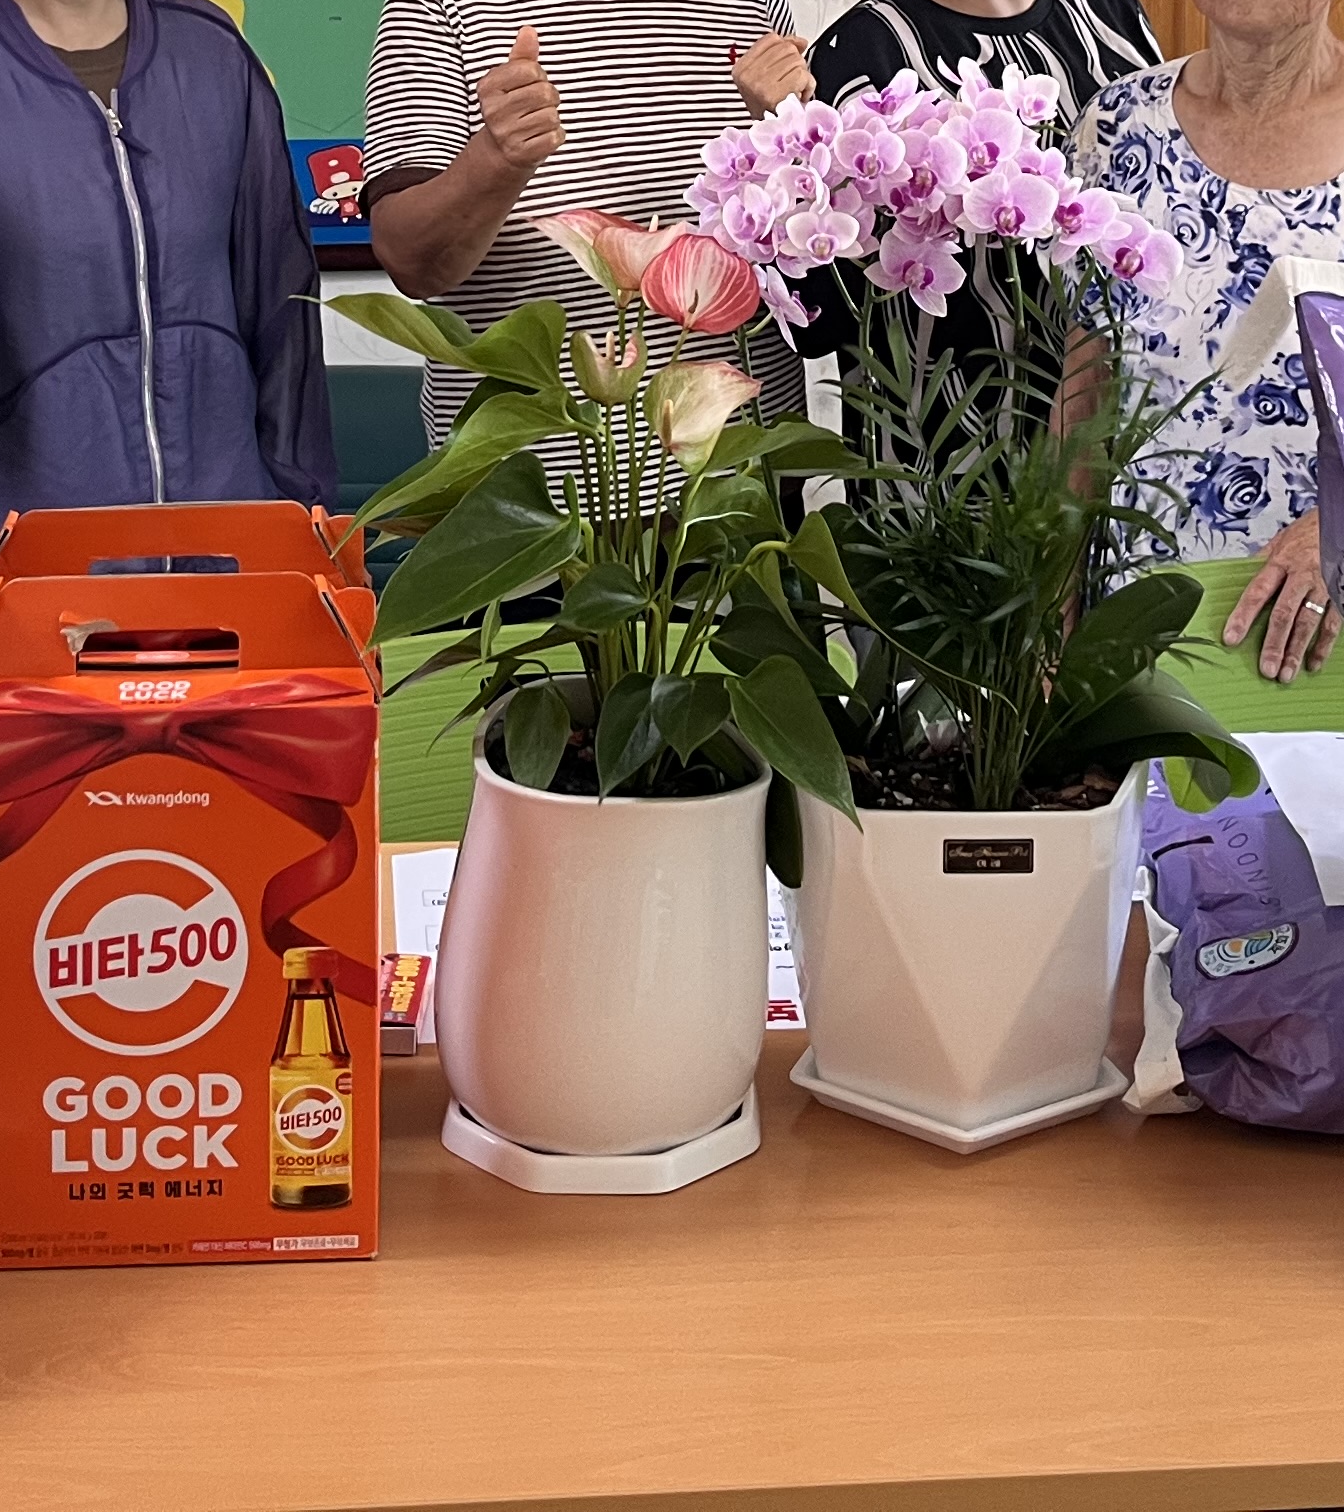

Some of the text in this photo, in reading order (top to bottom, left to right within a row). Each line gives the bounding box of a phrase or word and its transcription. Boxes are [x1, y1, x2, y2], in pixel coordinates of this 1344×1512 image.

[119, 681, 191, 691] GOOD
[119, 691, 187, 700] LUCK
[126, 790, 210, 807] Kwangdong
[48, 916, 238, 989] 비타500
[42, 1073, 243, 1121] GOOD
[280, 1106, 342, 1130] 비타500
[51, 1124, 239, 1173] LUCK
[276, 1153, 349, 1166] GOOD LUCK
[69, 1179, 223, 1201] 나의 굿럭 에너지
